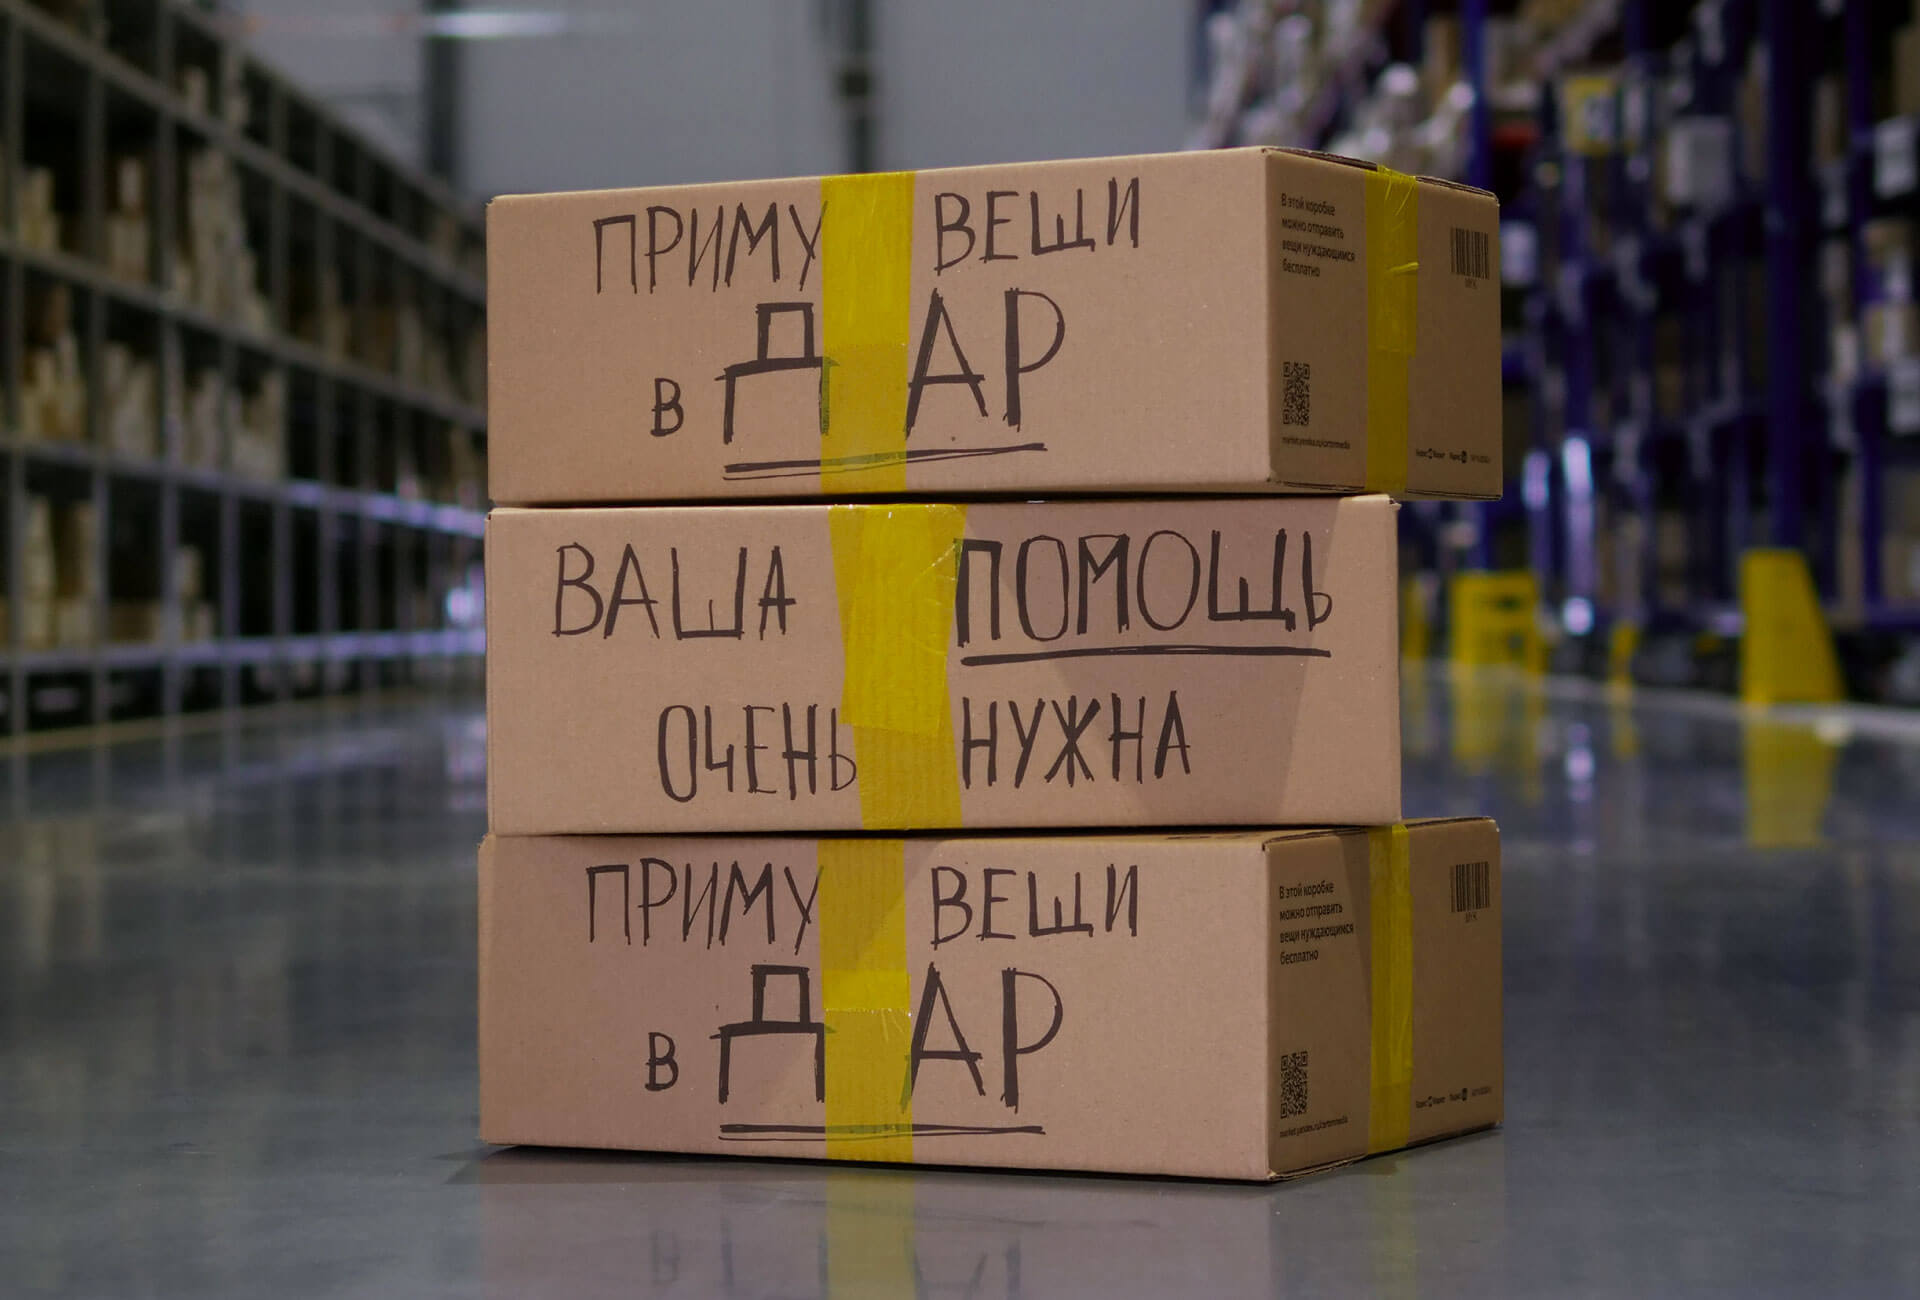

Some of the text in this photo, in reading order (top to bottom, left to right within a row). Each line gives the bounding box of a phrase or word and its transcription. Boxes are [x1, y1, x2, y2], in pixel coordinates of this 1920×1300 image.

[1305, 200, 1336, 216] коробке
[593, 176, 1140, 294] ПРИМУ ВЕЩИ
[1282, 217, 1345, 240] можно отправить
[1282, 239, 1301, 254] вещи
[1282, 258, 1320, 277] бесплатно
[714, 287, 1066, 445] ДАР
[552, 528, 1333, 648] ВАША ПОМОЩЬ
[658, 690, 1191, 803] ОЧЕНЬ НУЖНА
[1279, 879, 1335, 900] В этой коробке
[586, 857, 1138, 956] ПРИМУ ВЕЩИ
[1280, 903, 1343, 920] можно отправить
[1280, 923, 1354, 944] вещи нуждающимся
[1280, 950, 1319, 965] бесплатно
[709, 961, 1063, 1115] ДАР
